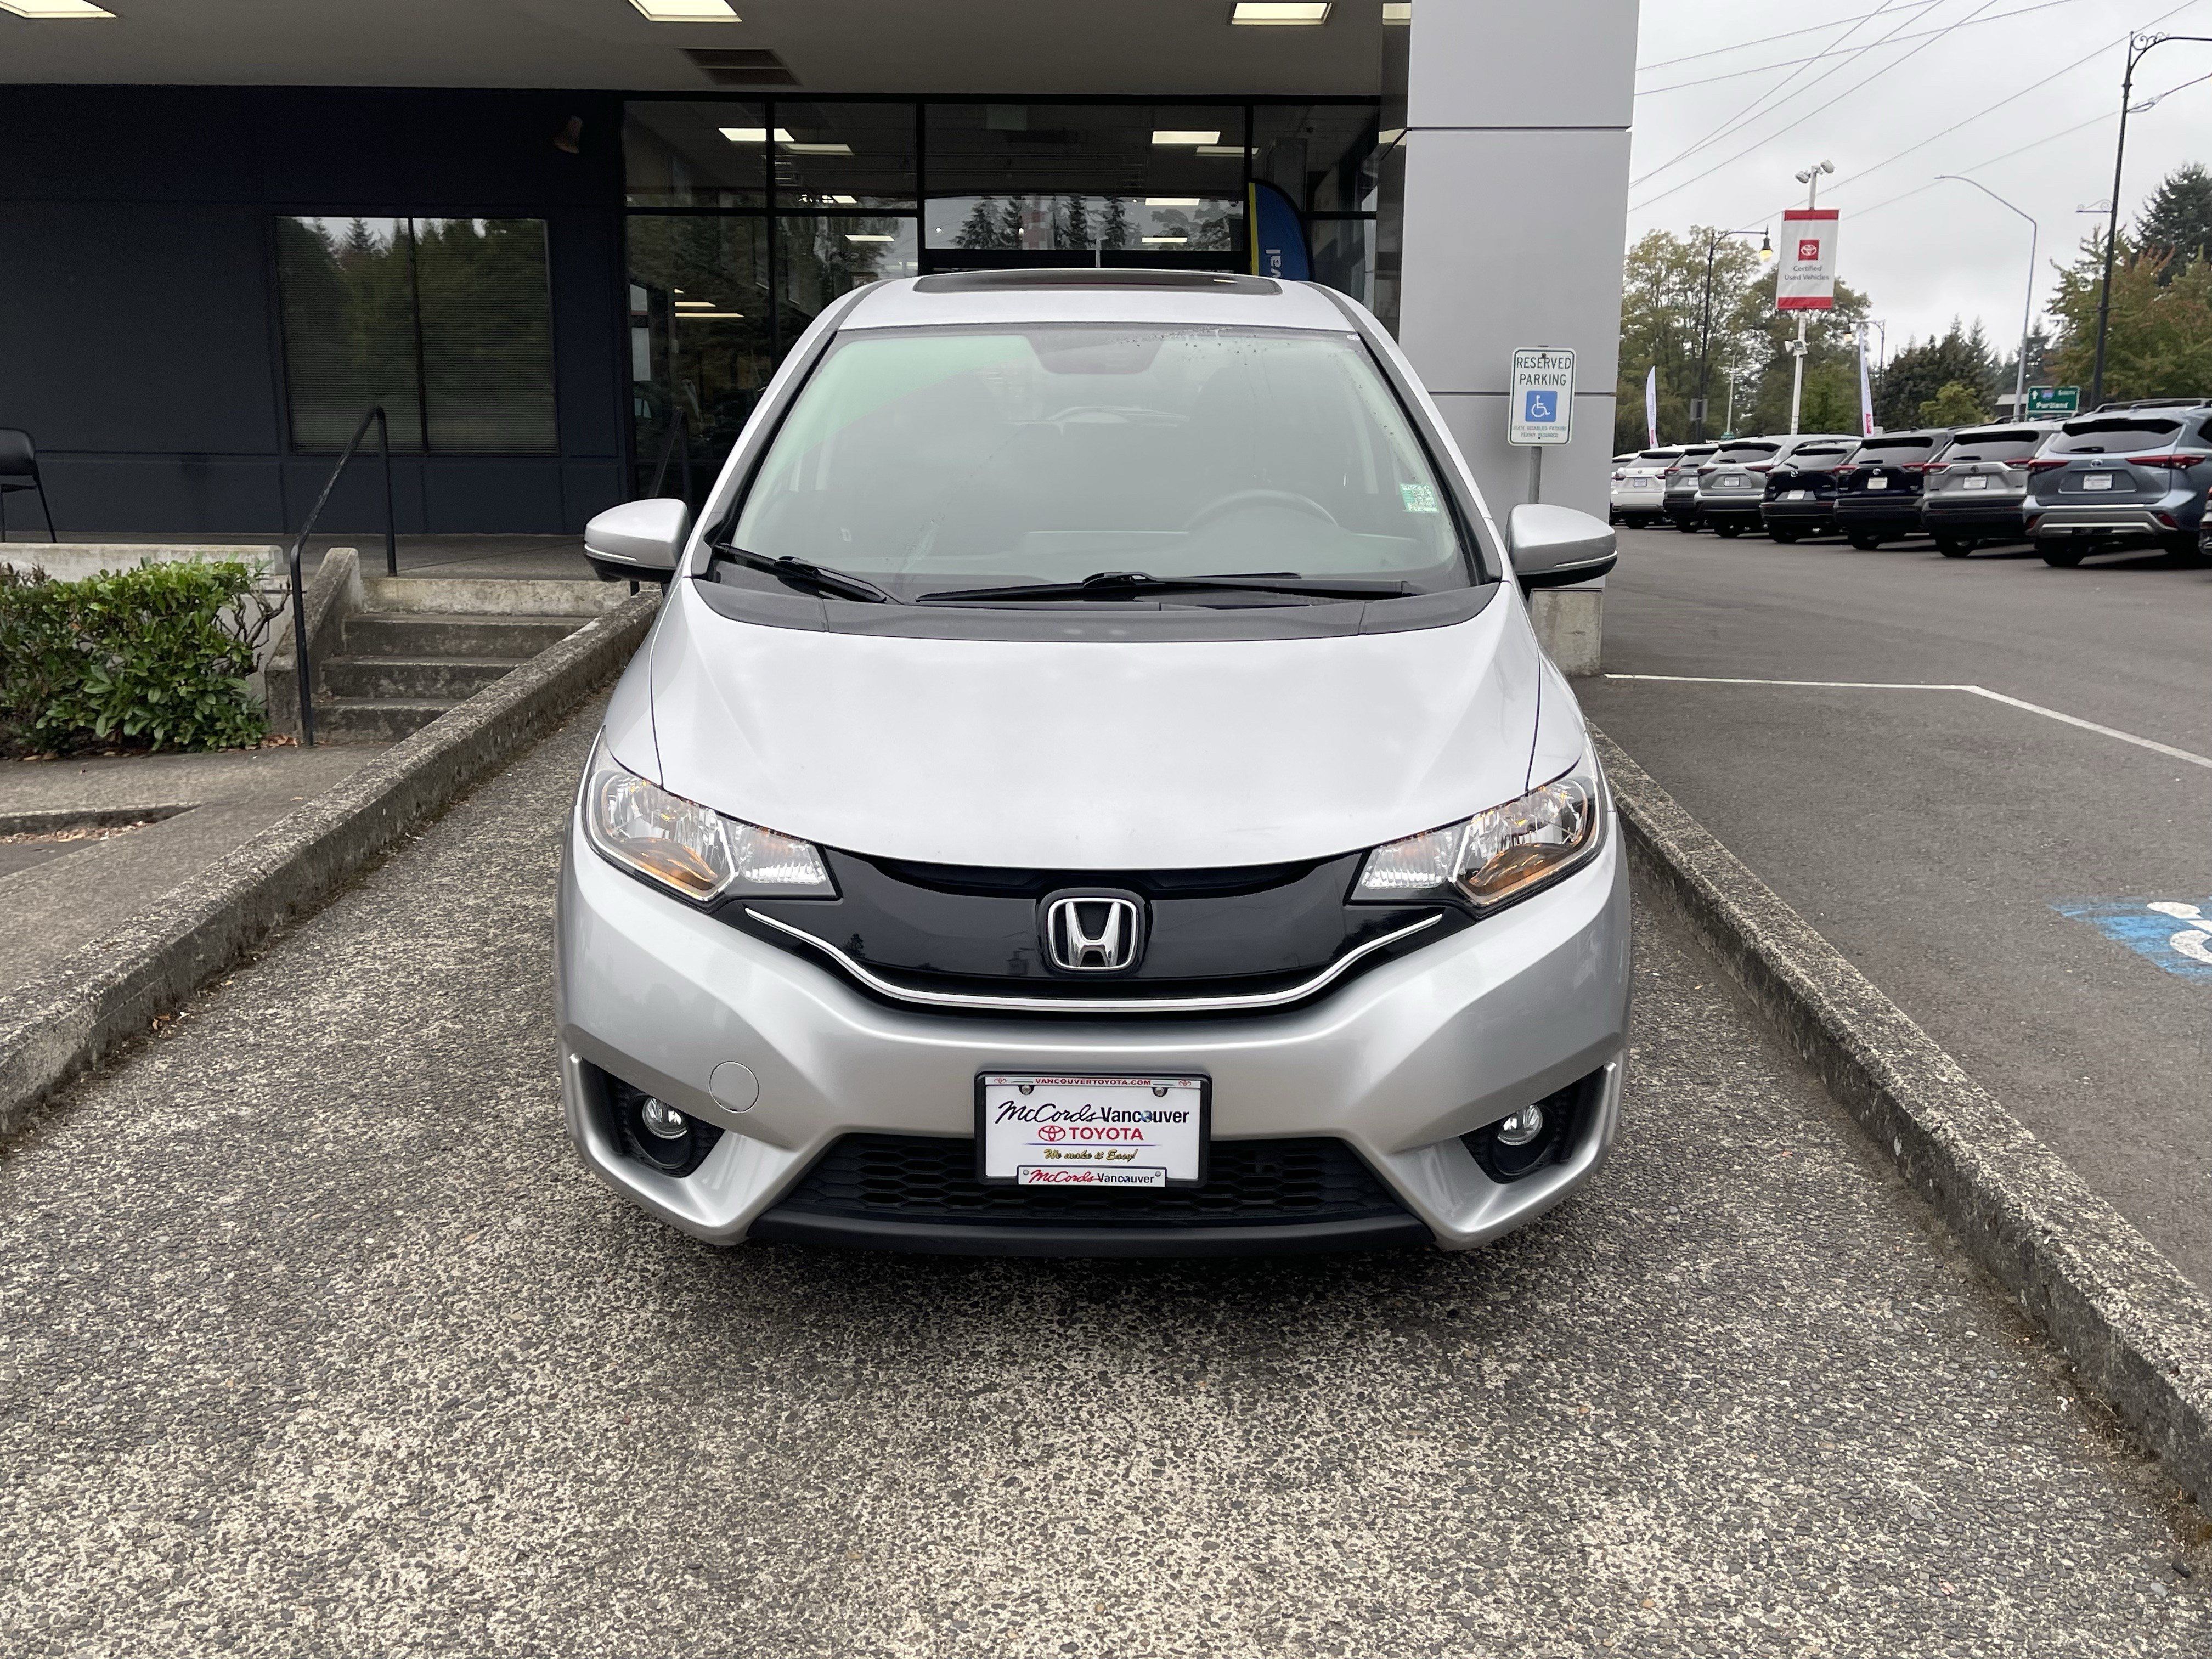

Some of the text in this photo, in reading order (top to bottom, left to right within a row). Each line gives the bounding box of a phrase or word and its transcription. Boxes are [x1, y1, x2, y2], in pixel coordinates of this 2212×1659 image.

[1516, 357, 1571, 369] RESERVED
[1519, 374, 1567, 386] PARKING
[1069, 1127, 1144, 1141] TOYOTA
[1043, 1148, 1138, 1162] We make it Easy!
